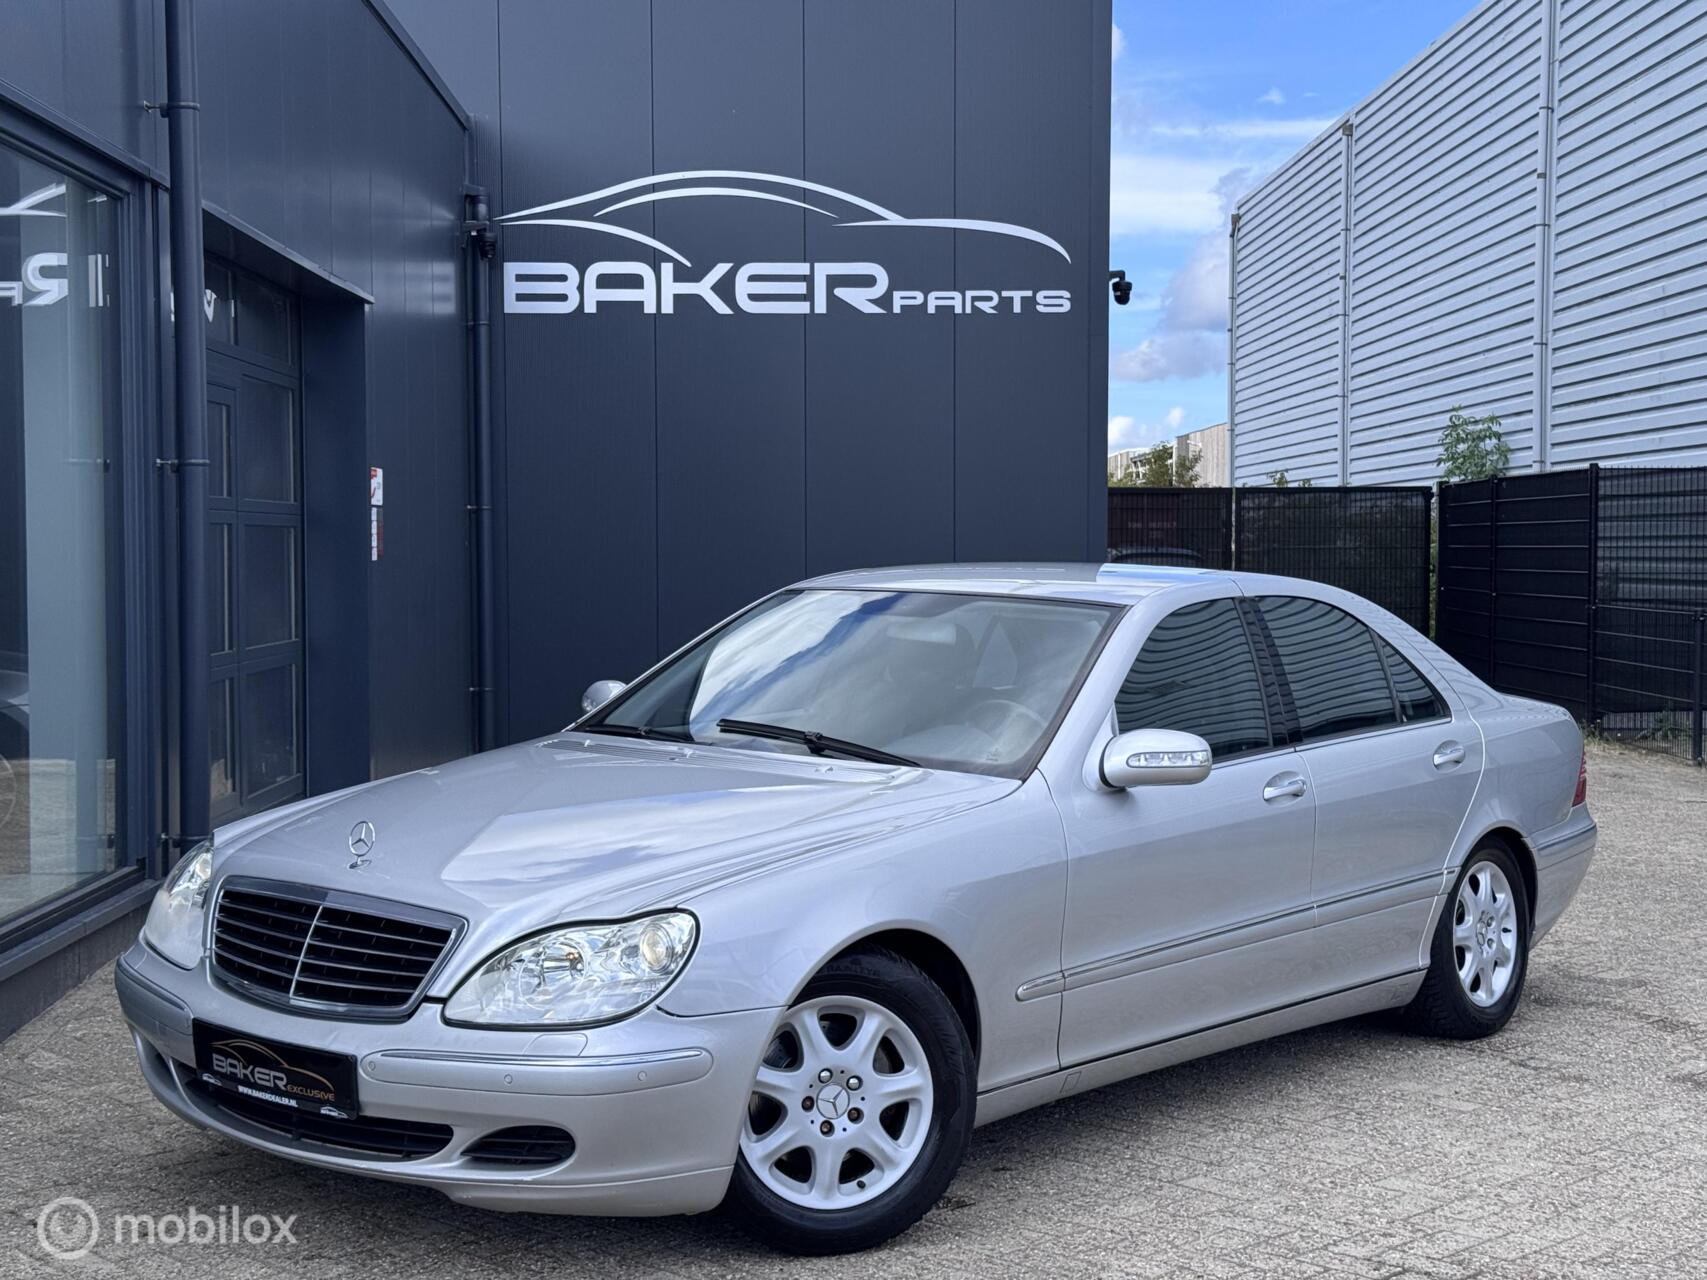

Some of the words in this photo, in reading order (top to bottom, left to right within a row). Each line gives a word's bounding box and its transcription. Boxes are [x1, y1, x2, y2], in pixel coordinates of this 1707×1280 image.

[503, 261, 889, 315] BAKER
[892, 289, 1072, 314] PARTS
[212, 1053, 288, 1091] BAKER
[287, 1084, 335, 1101] EXCLUSIVE
